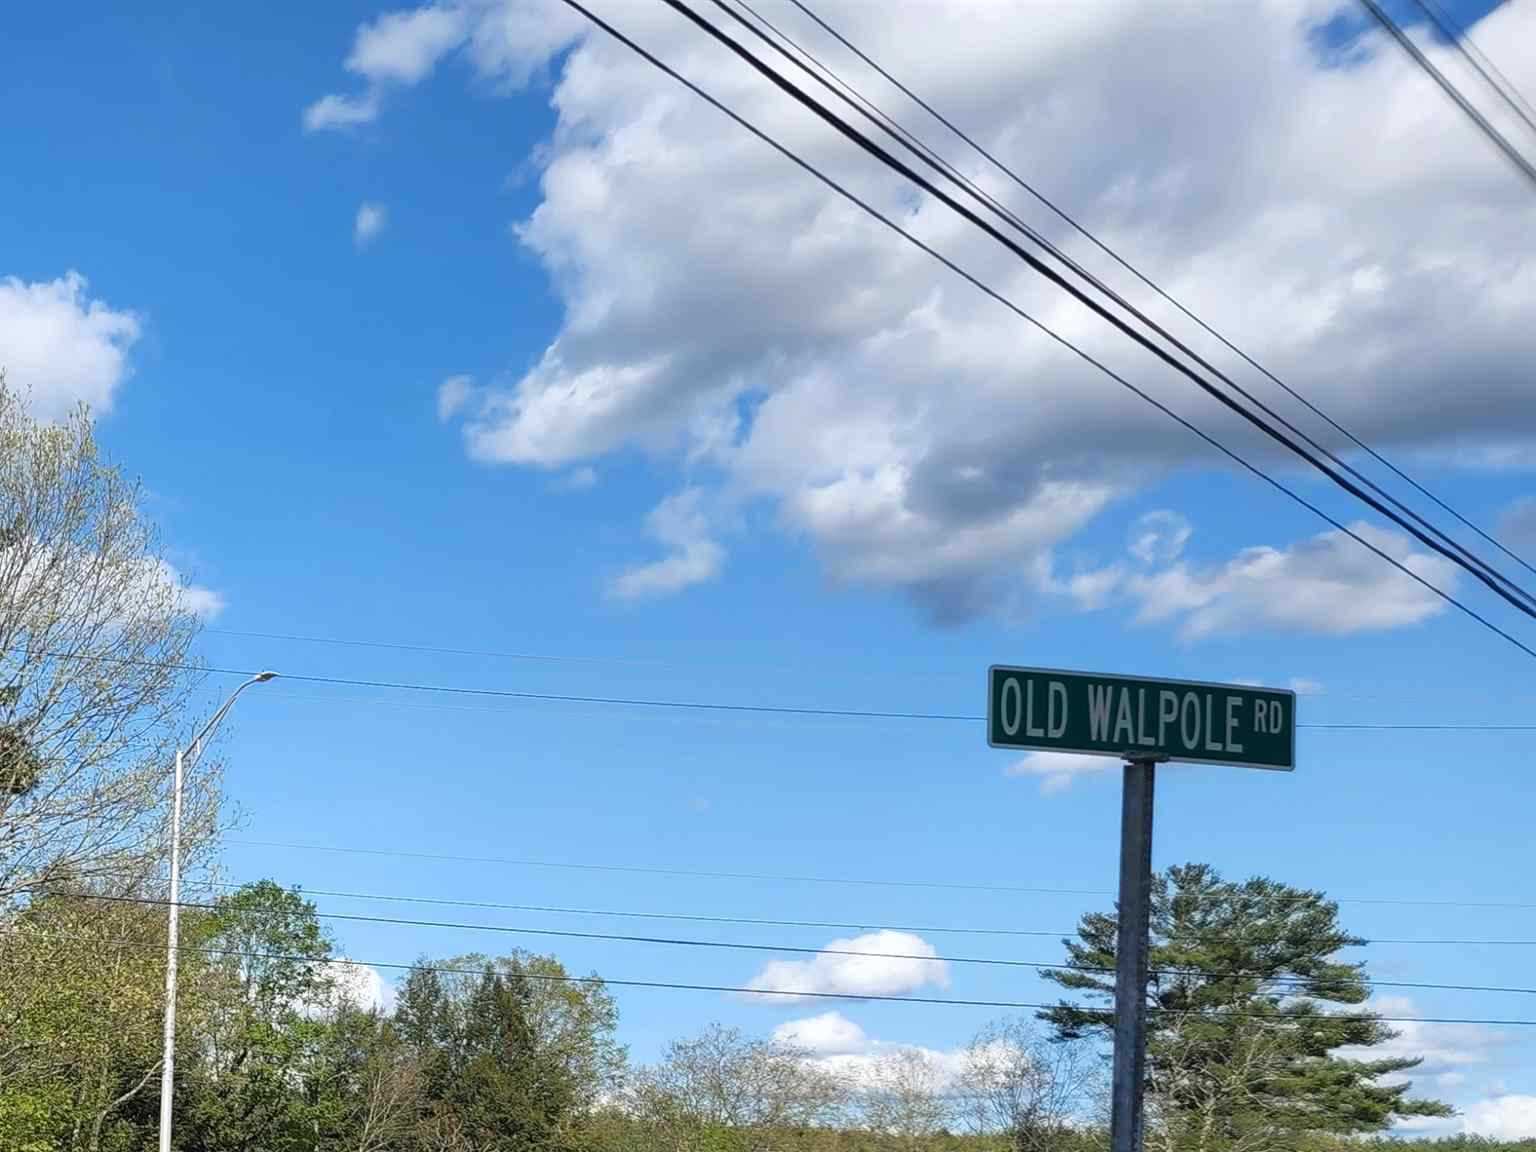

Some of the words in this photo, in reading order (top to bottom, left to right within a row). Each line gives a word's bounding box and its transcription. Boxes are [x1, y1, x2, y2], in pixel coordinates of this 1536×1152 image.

[1000, 677, 1068, 738] OLD
[1087, 684, 1244, 753] WALPOLE
[1253, 699, 1283, 734] RD
